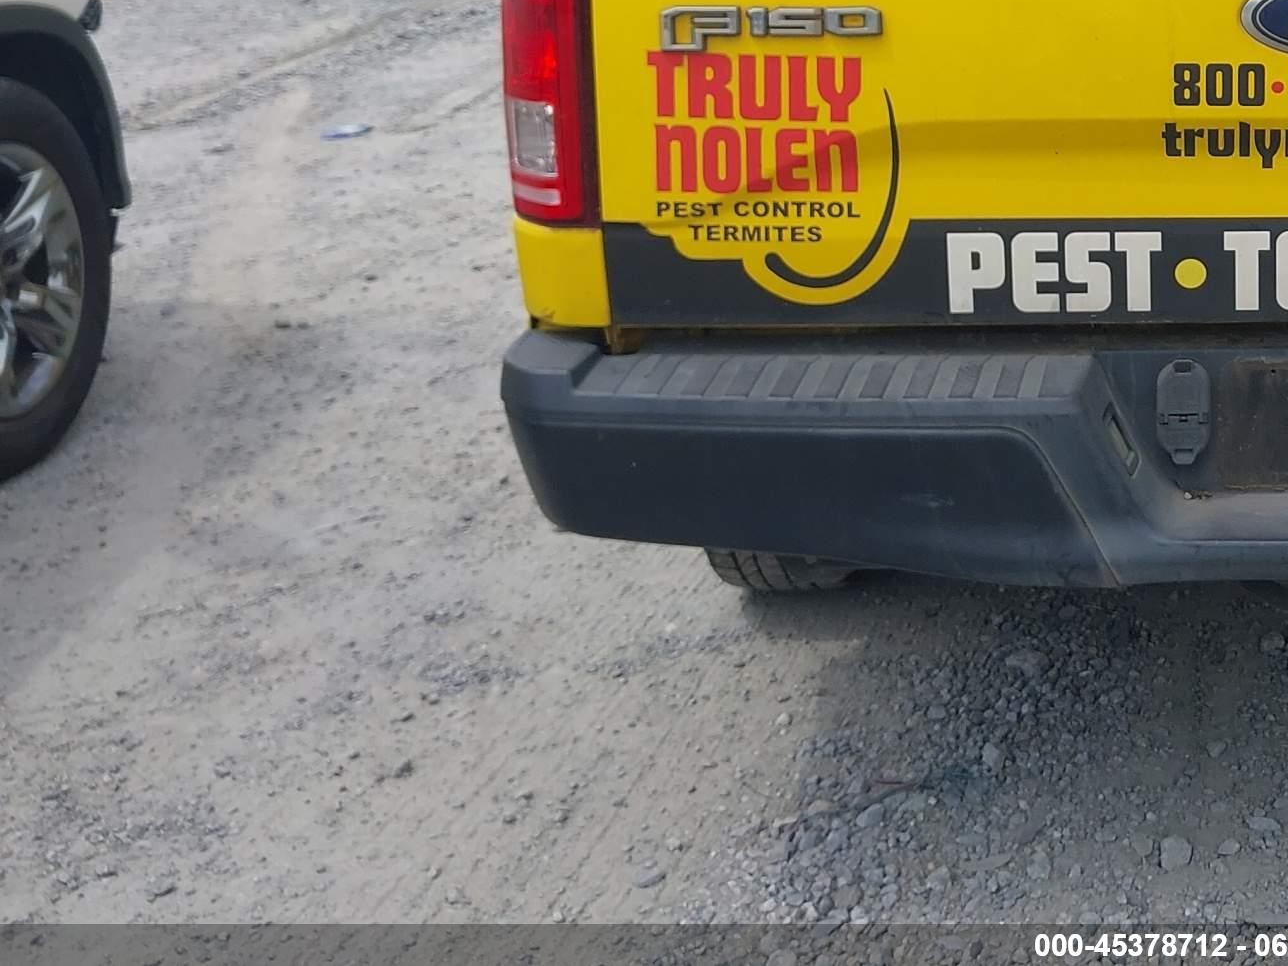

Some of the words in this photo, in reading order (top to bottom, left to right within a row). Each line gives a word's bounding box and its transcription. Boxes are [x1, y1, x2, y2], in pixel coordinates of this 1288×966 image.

[647, 51, 862, 123] TRULY
[654, 123, 860, 195] NOLEN
[656, 201, 723, 218] PEST
[734, 200, 861, 219] CONTROL
[688, 224, 823, 243] TERMITES
[946, 231, 1163, 315] PEST
